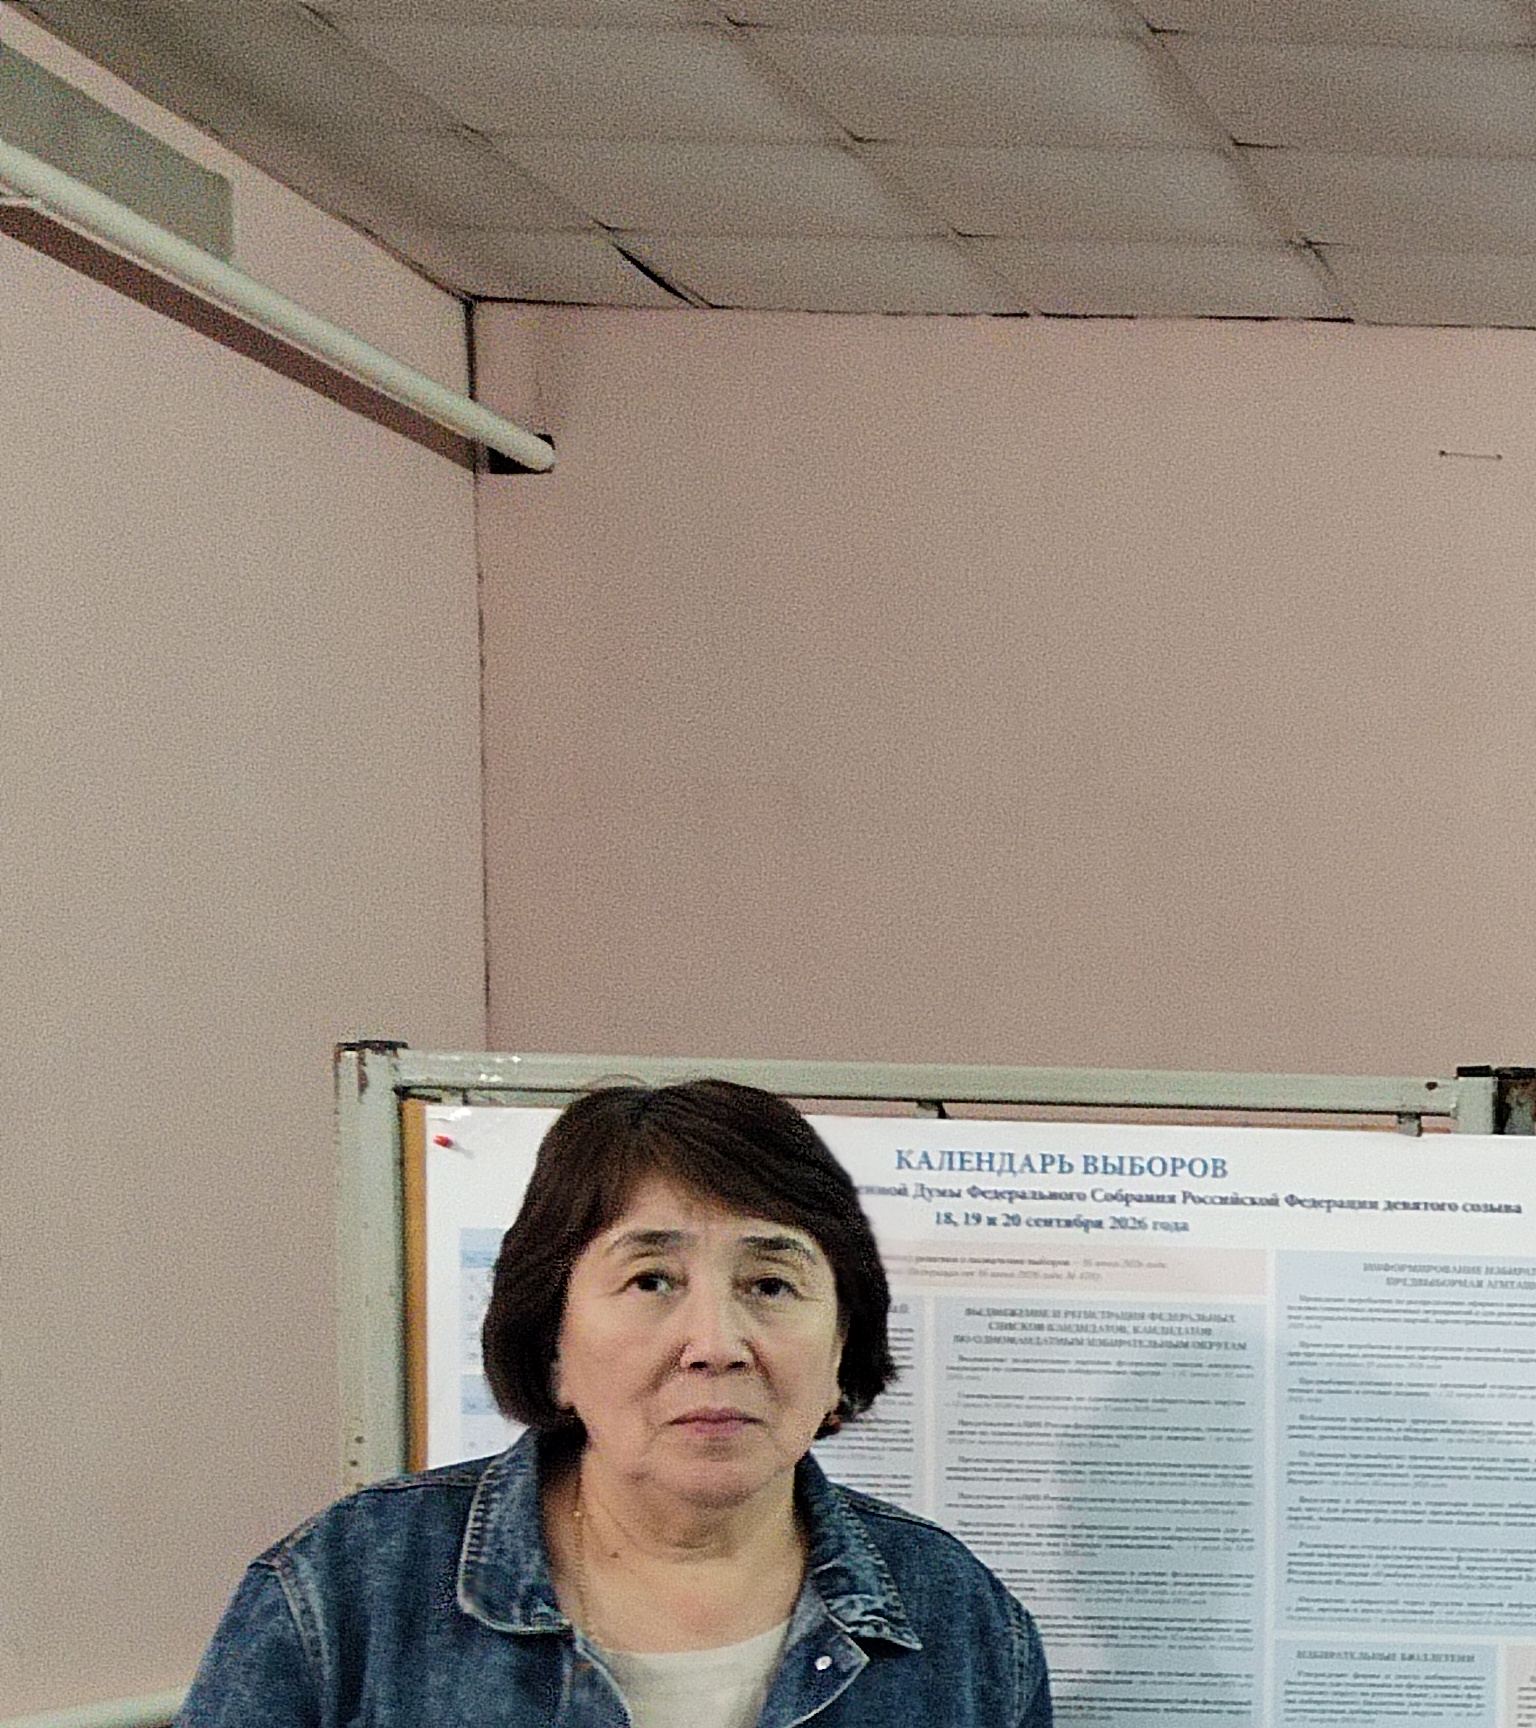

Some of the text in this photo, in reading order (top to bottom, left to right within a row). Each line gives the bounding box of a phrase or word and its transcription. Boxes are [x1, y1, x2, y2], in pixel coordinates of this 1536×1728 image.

[895, 1149, 1229, 1178] КАЛЕНДАРЬ ВЫБОРОВ
[912, 1182, 962, 1203] Думы
[967, 1185, 1087, 1204] Федерального
[1091, 1186, 1176, 1207] Собрания
[1182, 1189, 1279, 1208] Российской
[1284, 1192, 1379, 1214] Федерации
[1383, 1199, 1458, 1214] девятого
[935, 1212, 958, 1228] 18,
[963, 1212, 982, 1226] 19
[1002, 1213, 1021, 1227] 20
[1025, 1214, 1104, 1232] сентября
[1109, 1215, 1148, 1231] 2026
[1152, 1219, 1190, 1233] года
